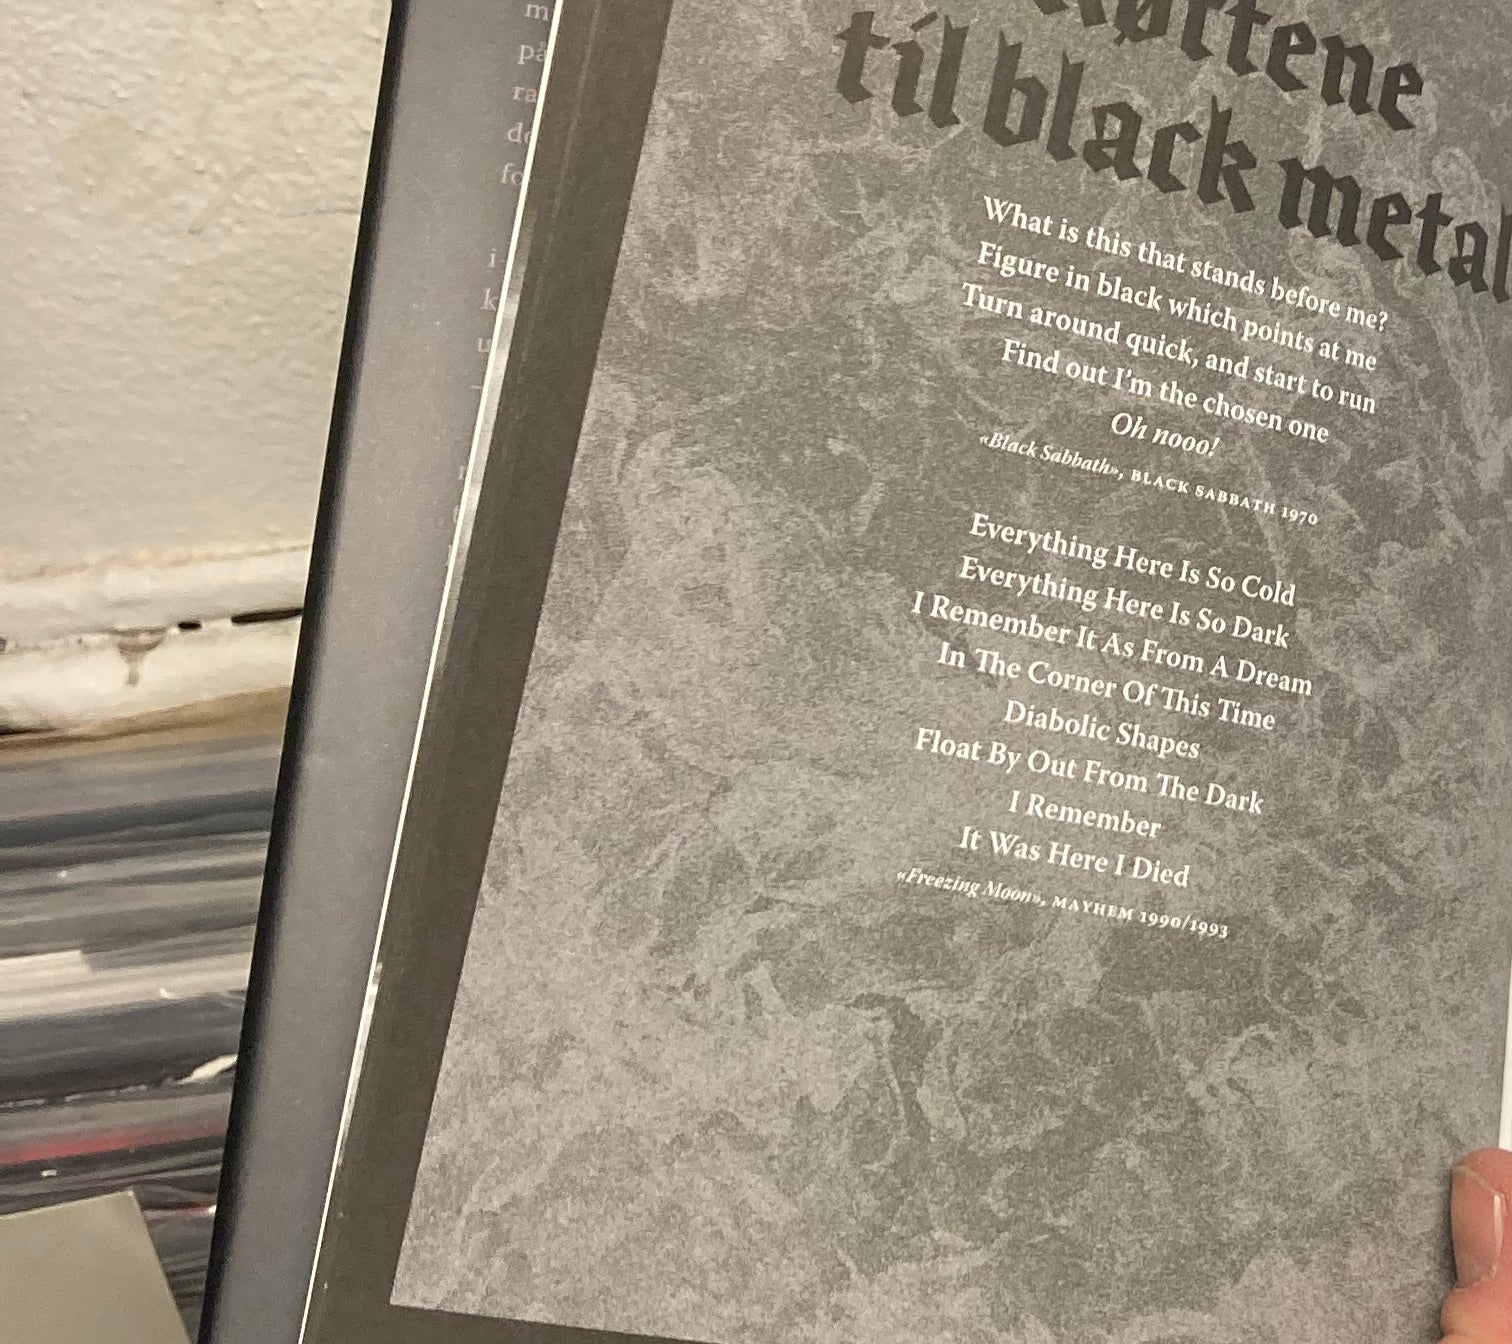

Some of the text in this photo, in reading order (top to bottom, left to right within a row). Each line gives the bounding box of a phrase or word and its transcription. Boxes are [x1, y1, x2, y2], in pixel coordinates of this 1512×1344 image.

[834, 10, 970, 129] til
[983, 30, 1258, 213] black
[977, 240, 1377, 374] Figure in black which points at me
[983, 195, 1389, 332] What is this that stands before me?
[961, 282, 1376, 415] Turn around quick, and start to run
[1001, 337, 1061, 374] Find
[1065, 361, 1109, 386] out
[1159, 380, 1198, 411] the
[1202, 391, 1283, 431] chosen
[1288, 419, 1330, 444] one
[1111, 412, 1220, 457] Oh nooo!
[1130, 468, 1190, 494] BLACK
[1194, 484, 1276, 515] SABBATH
[1281, 506, 1319, 526] 1970
[957, 554, 1290, 649] Everything Here Is So Dark
[968, 511, 1296, 607] Everything Here Is So Cold
[911, 591, 1312, 696] I Remember It As From A Dream
[936, 641, 1276, 731] In The Corner Of This Time
[914, 727, 1265, 816] Float By Out From The Dark
[1002, 699, 1201, 760] Diabolic Shapes
[957, 825, 1191, 888] It Was Here I Died
[1008, 789, 1162, 839] I Remember
[1052, 895, 1134, 920] MAYHEM
[1140, 912, 1229, 939] 1990/1993
